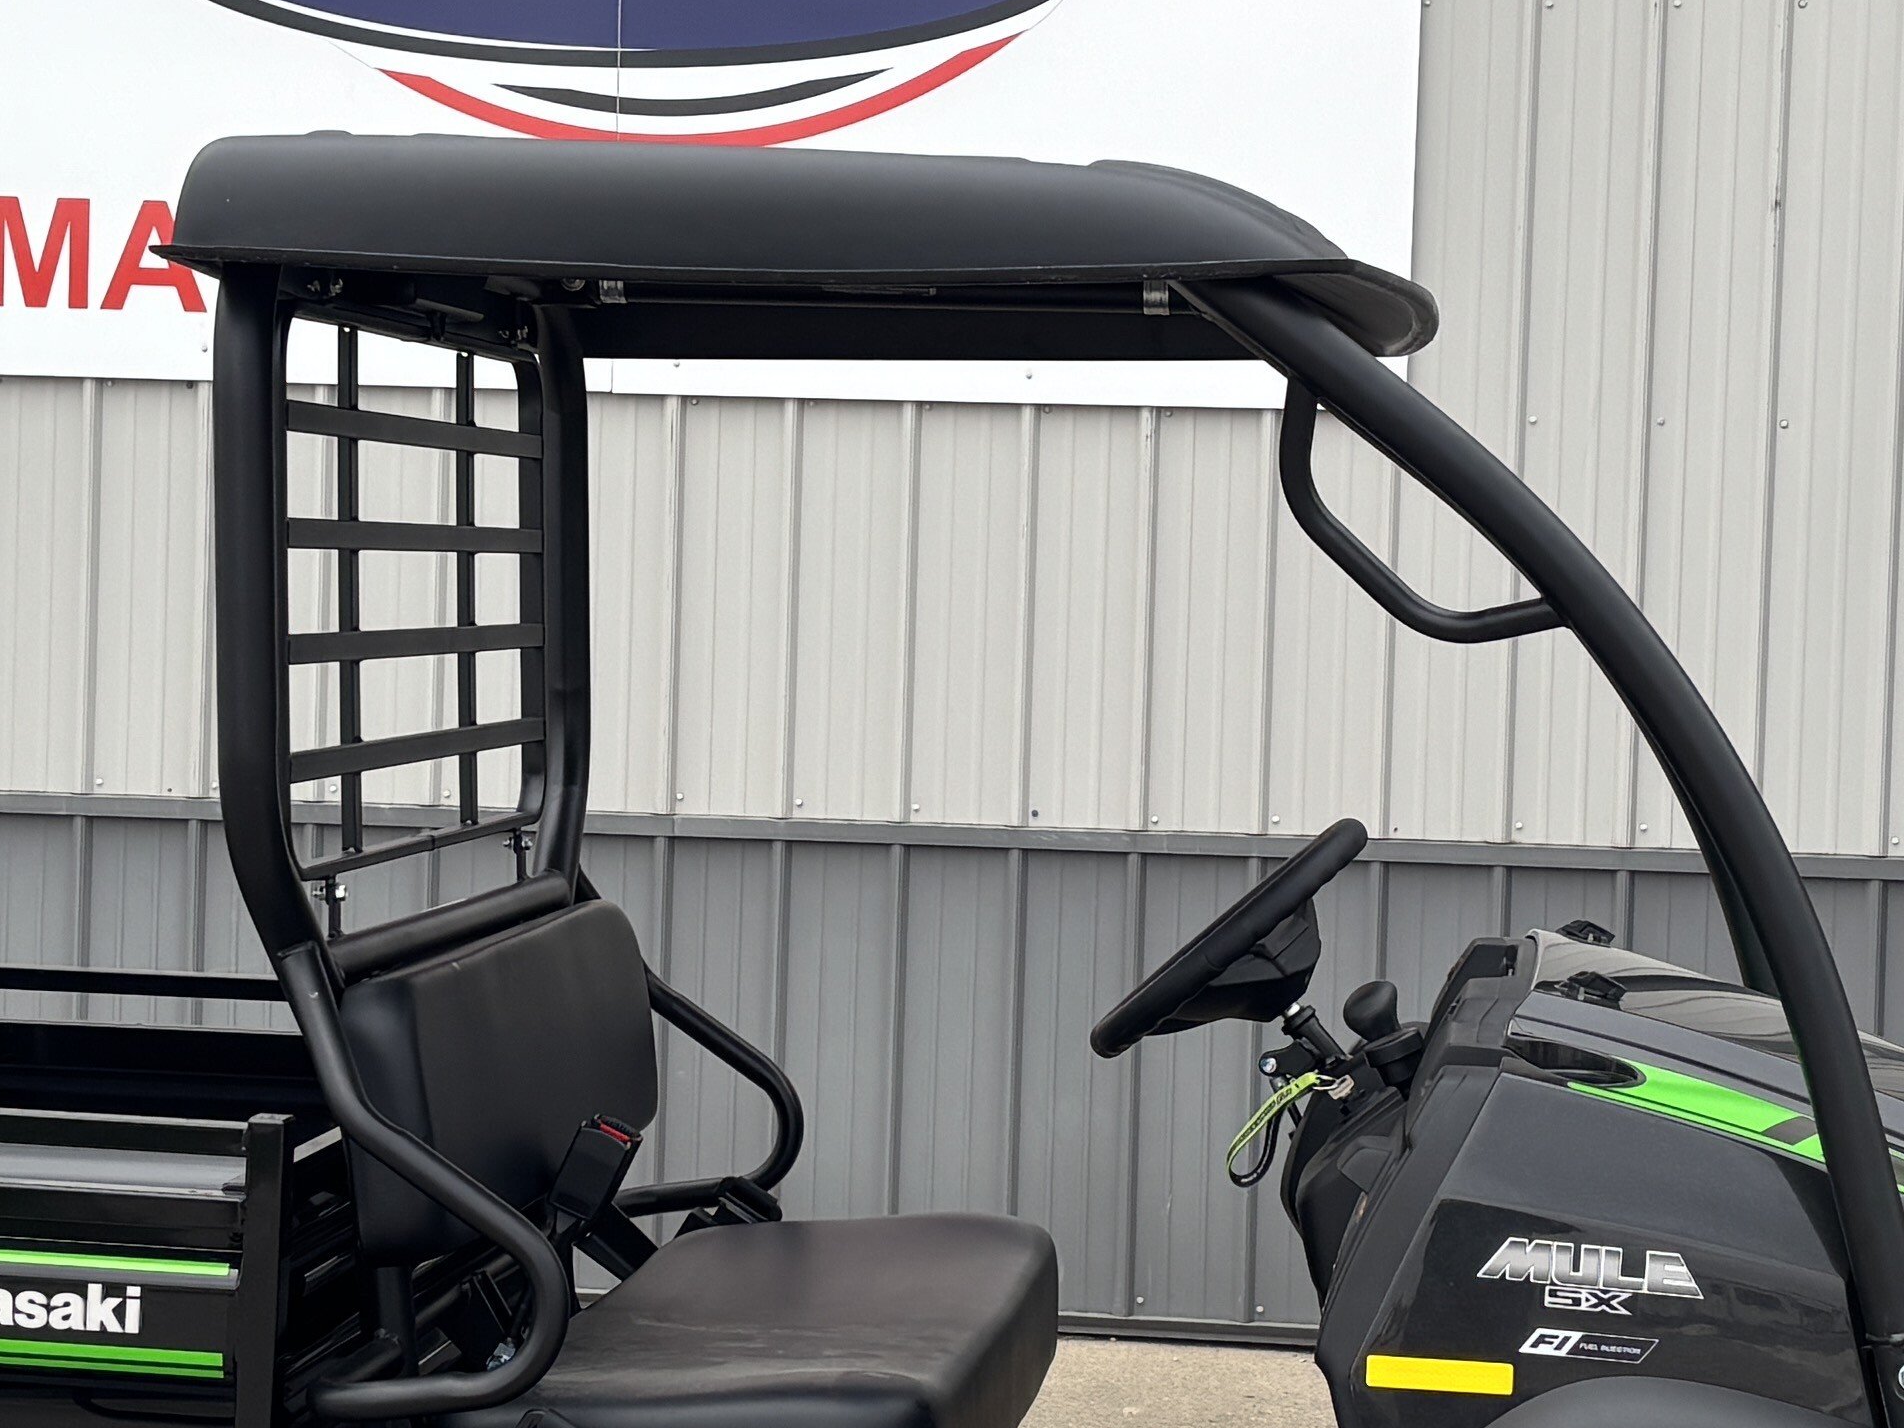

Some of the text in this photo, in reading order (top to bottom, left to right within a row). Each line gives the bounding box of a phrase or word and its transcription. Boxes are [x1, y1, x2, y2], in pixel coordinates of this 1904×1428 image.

[1476, 1236, 1704, 1300] MULE
[1544, 1285, 1633, 1316] SX
[1529, 1333, 1573, 1352] FI
